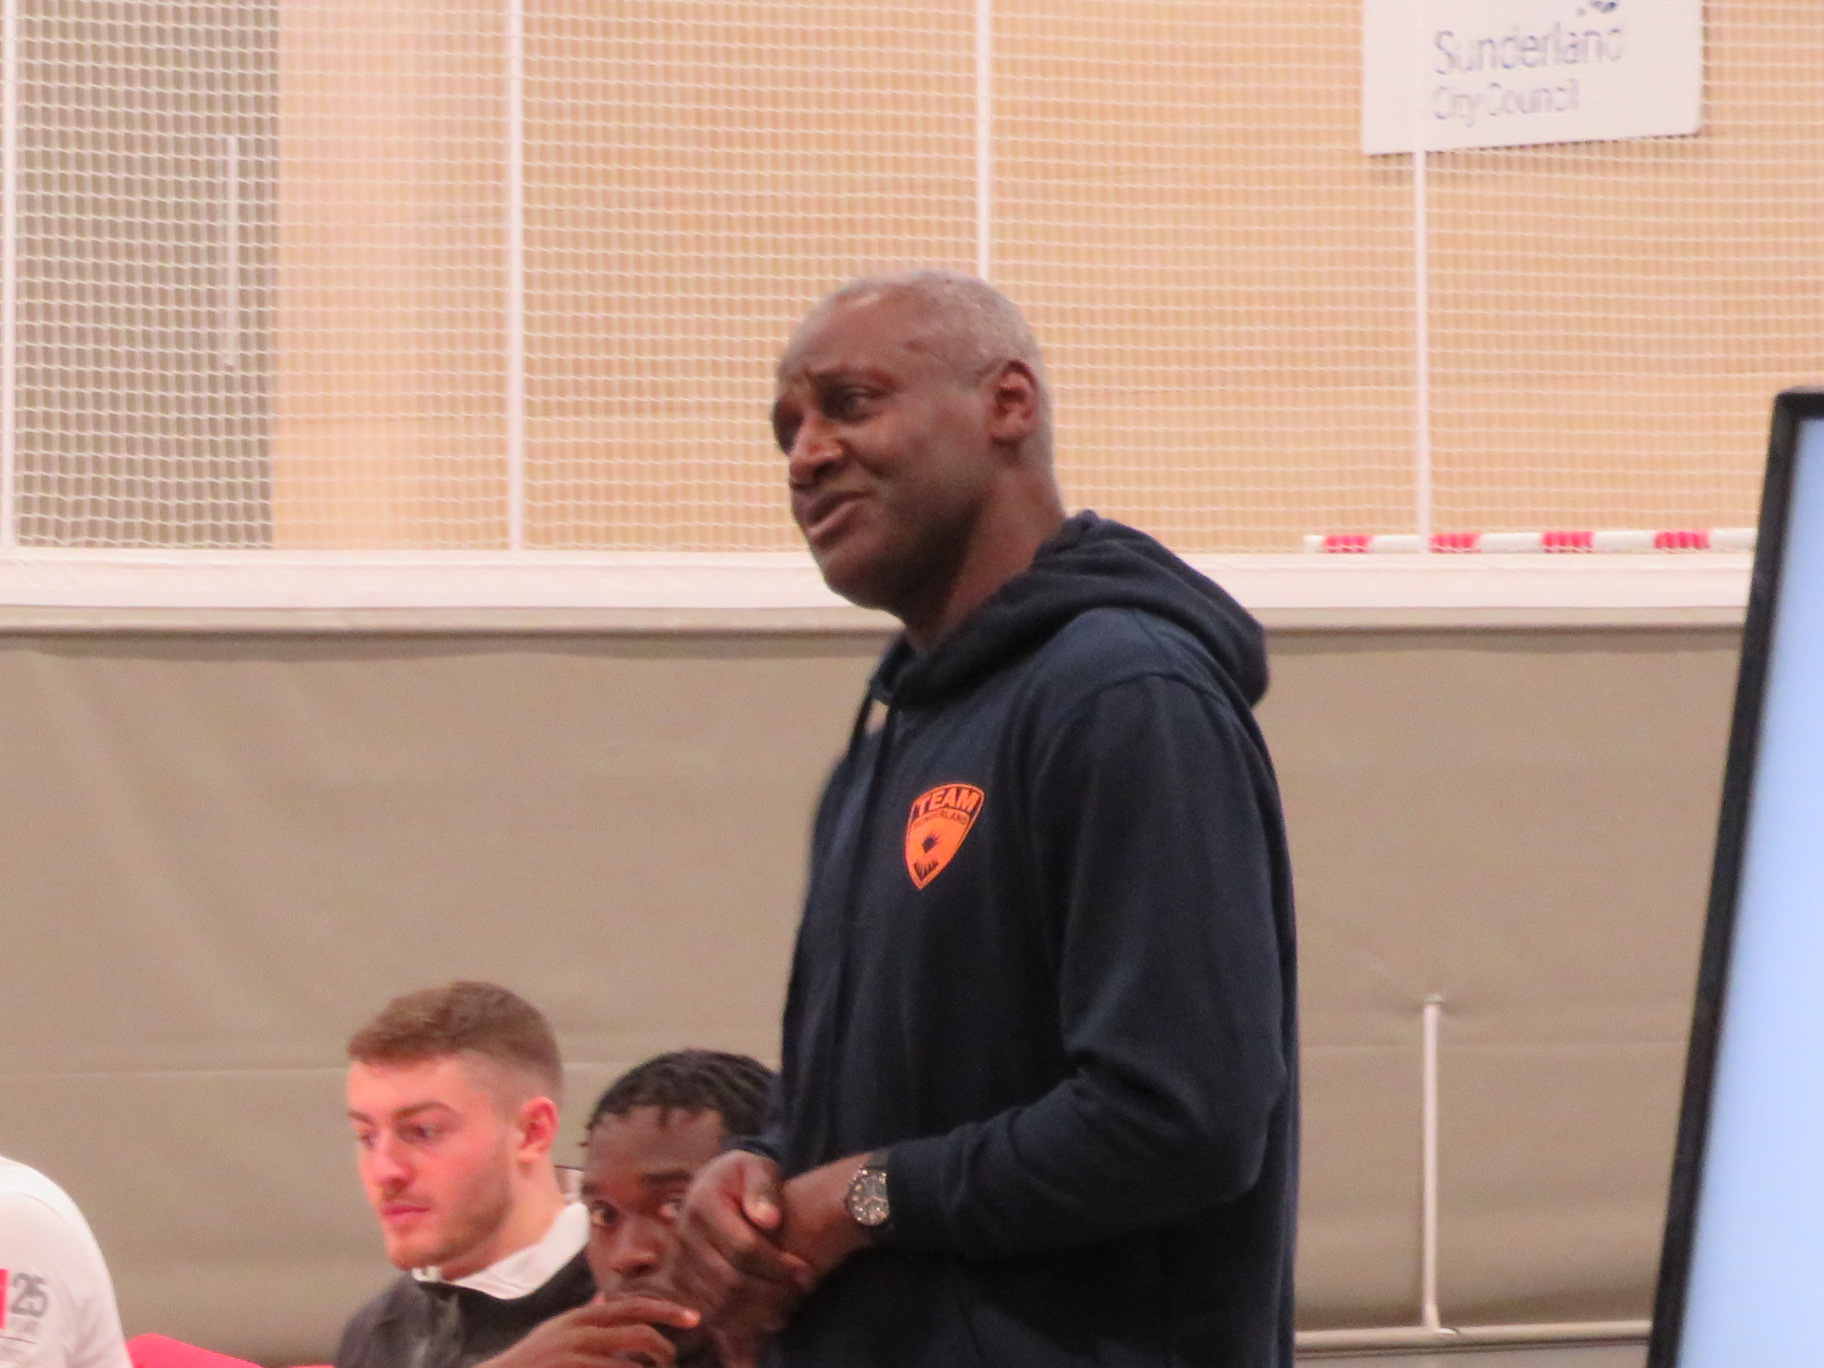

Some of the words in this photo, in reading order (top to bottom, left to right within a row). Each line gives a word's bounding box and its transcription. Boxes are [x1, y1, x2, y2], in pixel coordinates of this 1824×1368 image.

[1434, 22, 1625, 75] Sunderland
[1432, 84, 1478, 127] City
[1487, 78, 1580, 117] Council
[916, 786, 980, 818] TEAM
[11, 1272, 49, 1318] 25
